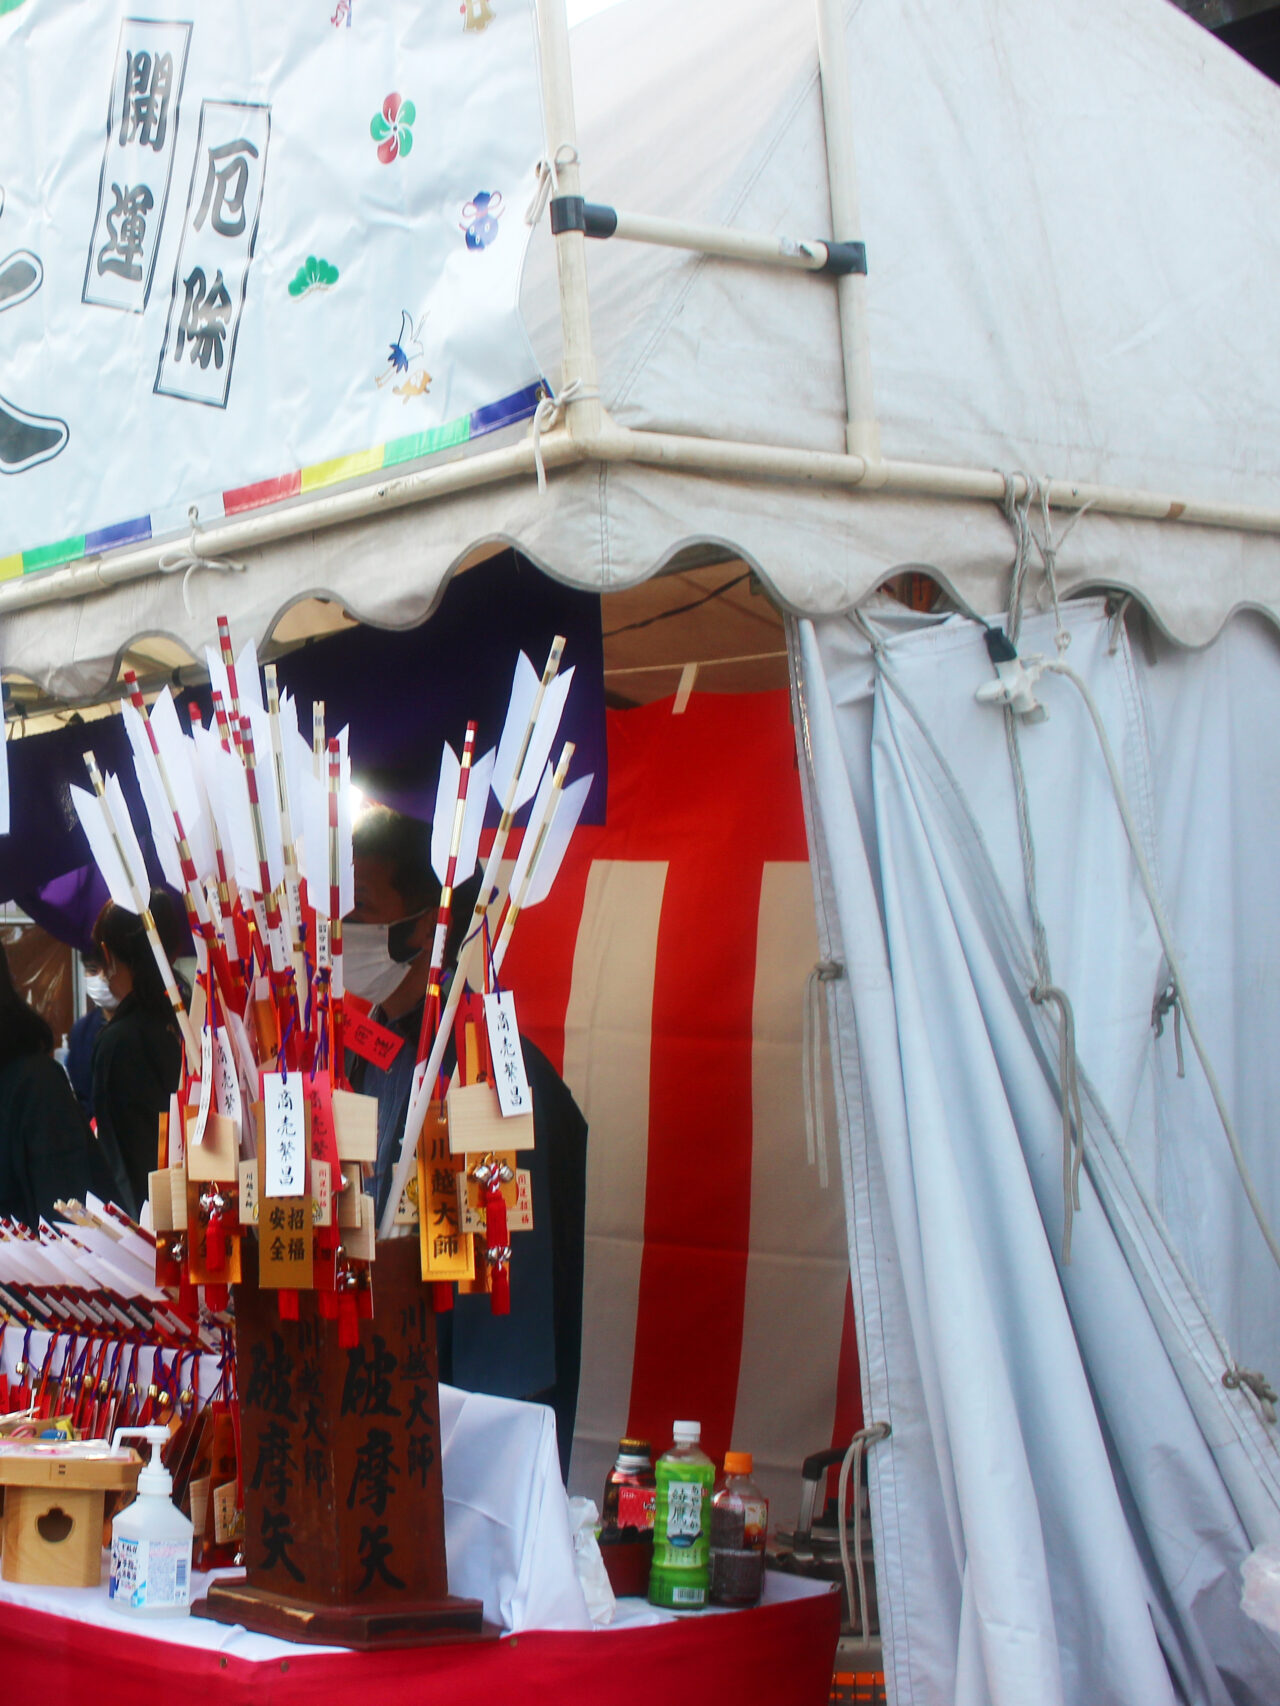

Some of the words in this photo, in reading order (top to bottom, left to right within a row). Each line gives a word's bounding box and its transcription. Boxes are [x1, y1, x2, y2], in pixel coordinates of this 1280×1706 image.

[98, 50, 174, 281] 開運
[175, 138, 258, 370] 厄除
[277, 1089, 297, 1186] 商売繁昌
[431, 1137, 459, 1259] 川越大師
